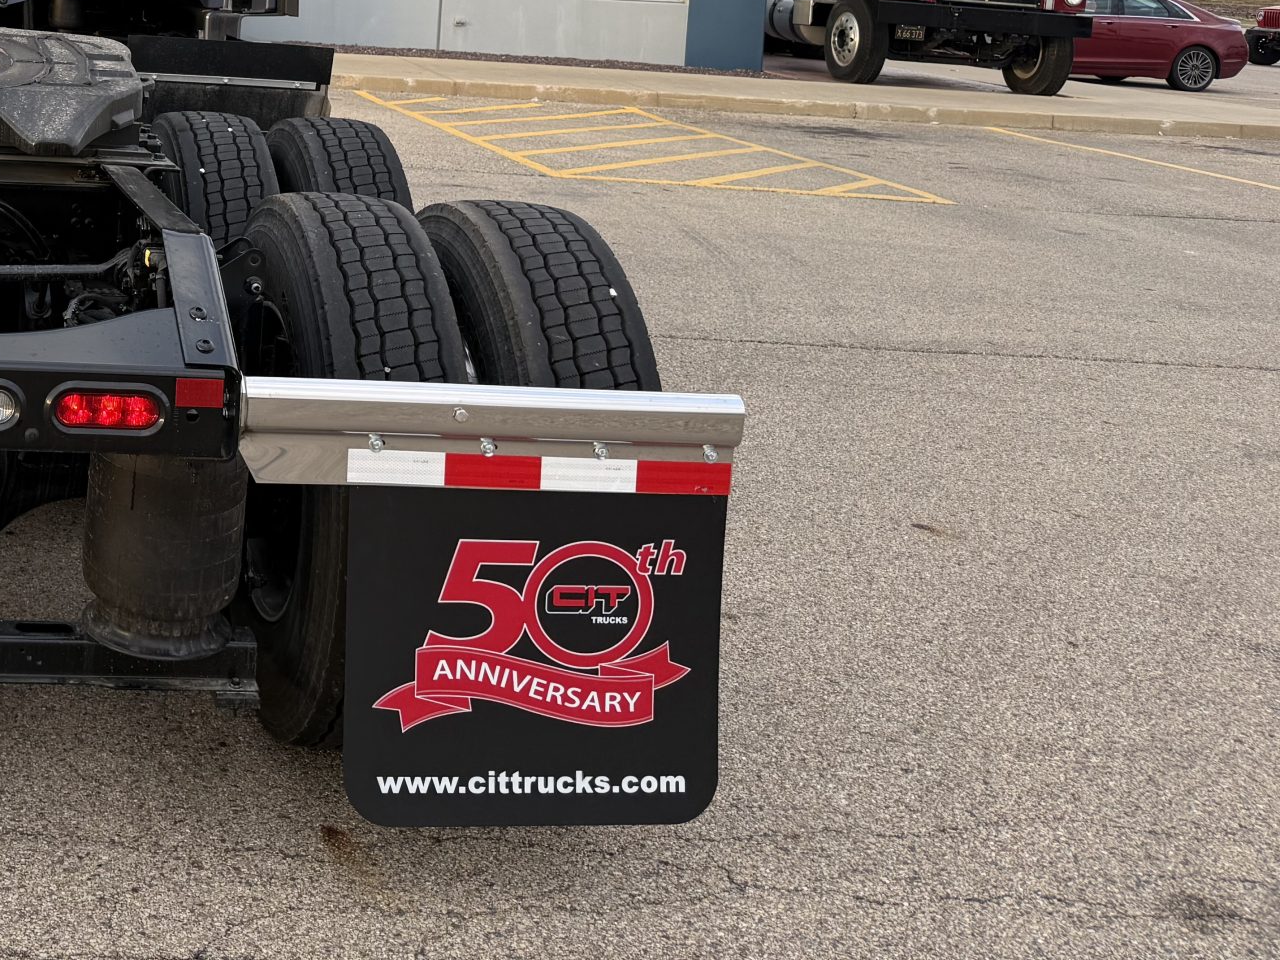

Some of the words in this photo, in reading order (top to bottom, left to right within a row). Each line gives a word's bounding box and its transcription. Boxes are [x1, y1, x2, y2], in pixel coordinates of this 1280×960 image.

[545, 585, 631, 614] CIT
[591, 616, 628, 624] TRUCKS
[432, 659, 641, 712] ANNIVERSARY
[376, 770, 686, 794] www.cittrucks.com
